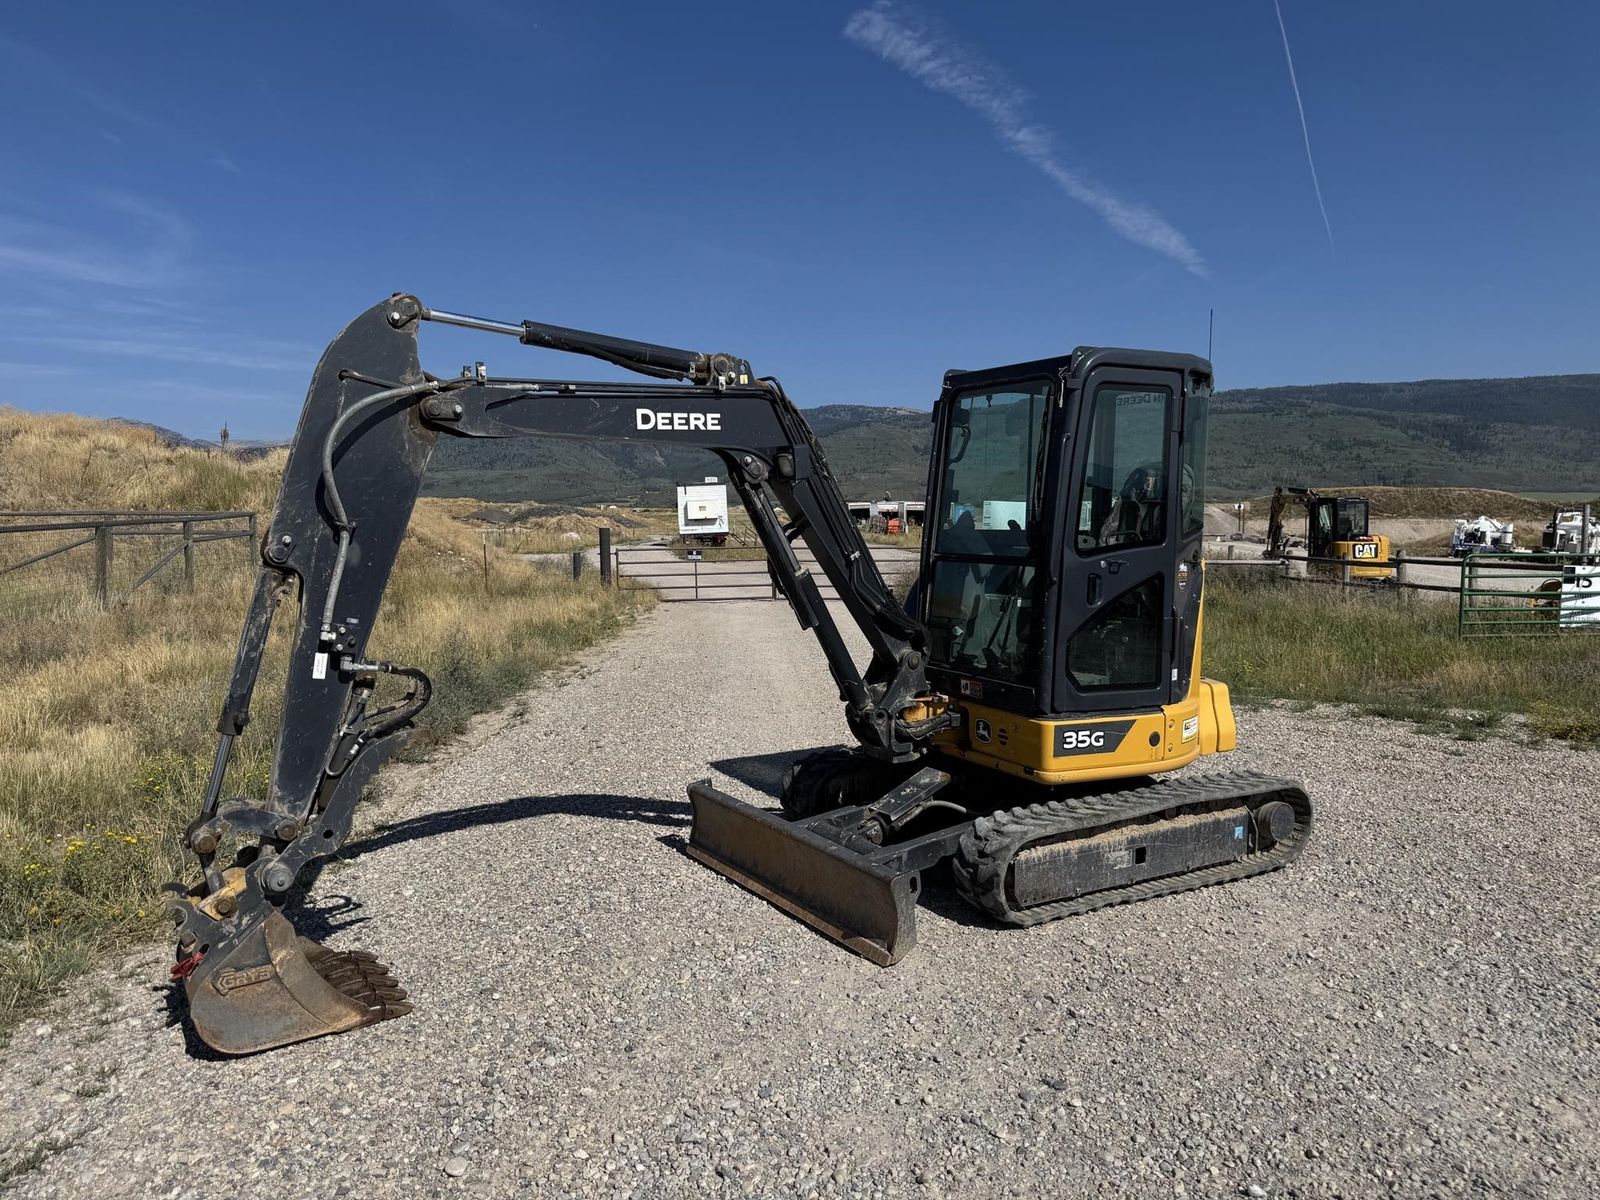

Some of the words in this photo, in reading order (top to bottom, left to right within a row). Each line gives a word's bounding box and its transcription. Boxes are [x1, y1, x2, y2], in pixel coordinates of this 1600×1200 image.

[635, 408, 721, 431] DEERE
[1354, 544, 1377, 558] CAT
[1063, 730, 1105, 749] 35G
